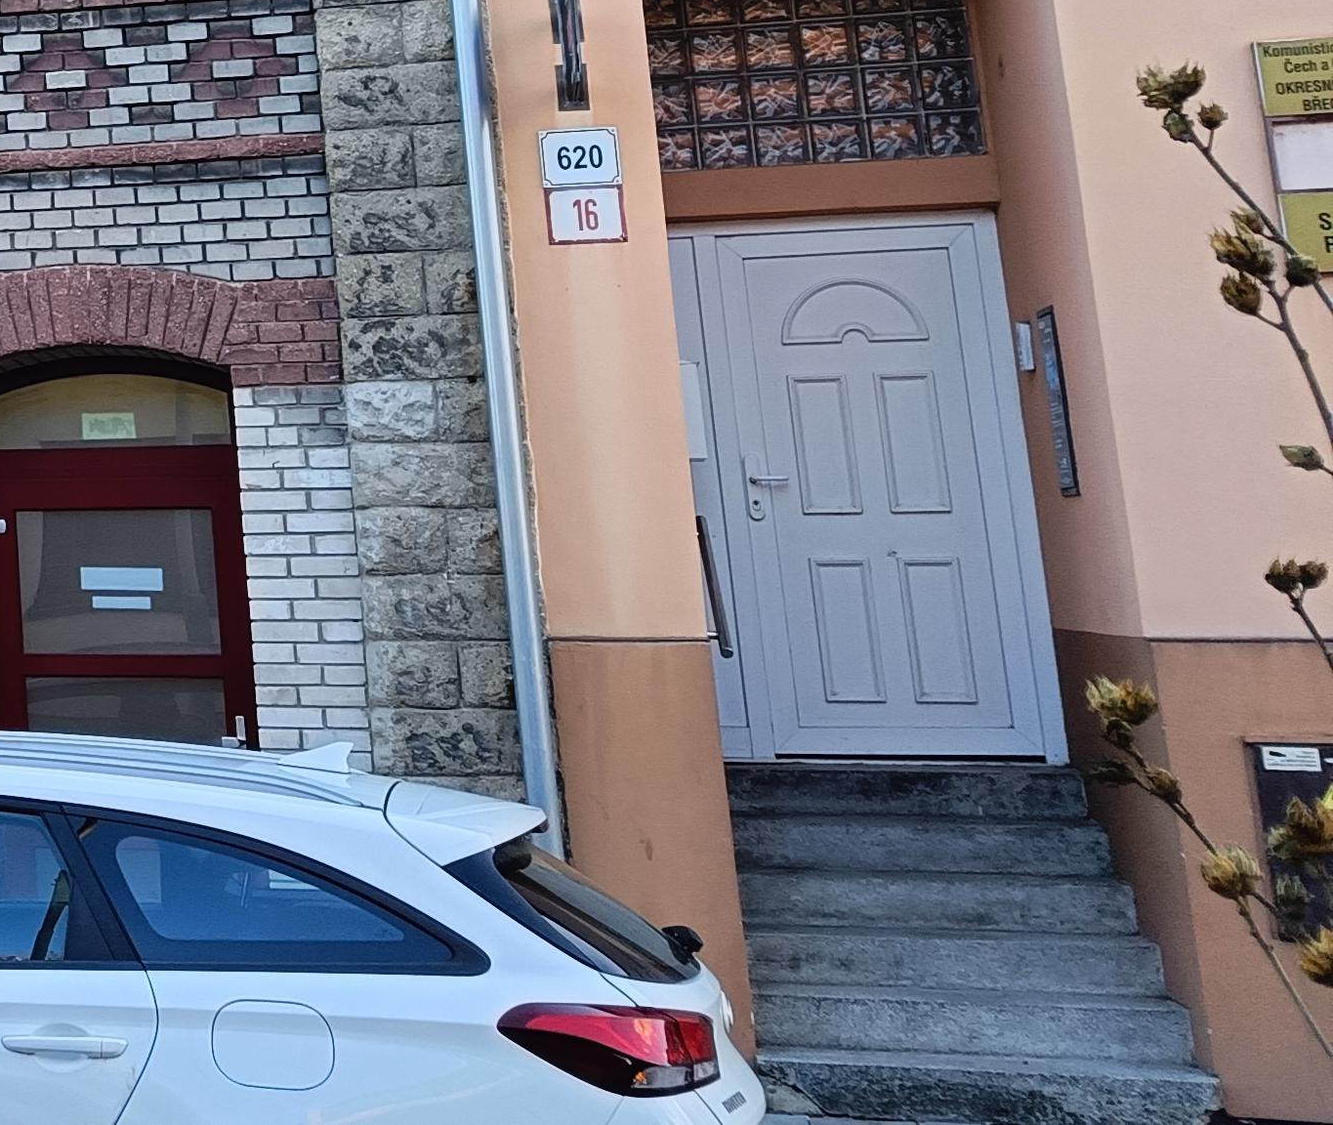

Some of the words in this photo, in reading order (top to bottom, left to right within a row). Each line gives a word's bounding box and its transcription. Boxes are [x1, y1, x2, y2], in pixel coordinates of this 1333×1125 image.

[1284, 58, 1318, 73] Čech
[1321, 61, 1330, 71] a
[557, 144, 603, 170] 620
[572, 198, 599, 231] 16
